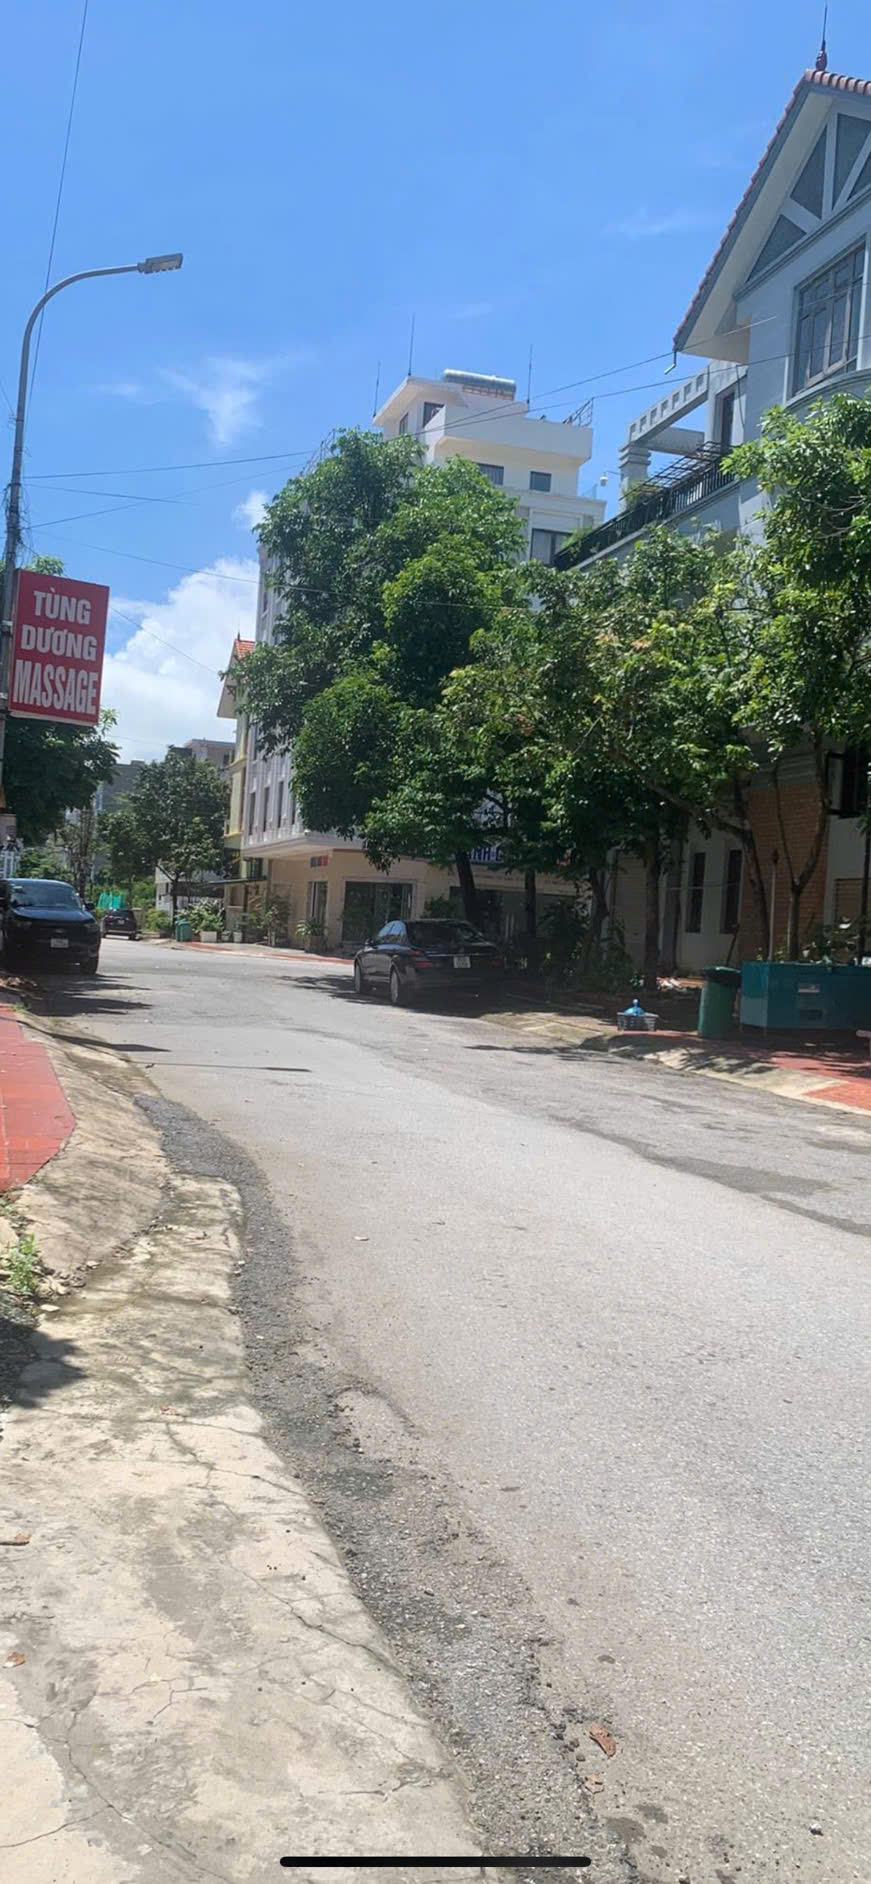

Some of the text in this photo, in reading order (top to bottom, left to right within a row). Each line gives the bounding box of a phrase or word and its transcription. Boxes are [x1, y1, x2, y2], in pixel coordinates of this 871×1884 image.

[34, 587, 91, 625] TÙNG
[21, 625, 97, 661] DƯƠNG
[13, 660, 99, 715] MASSAGE
